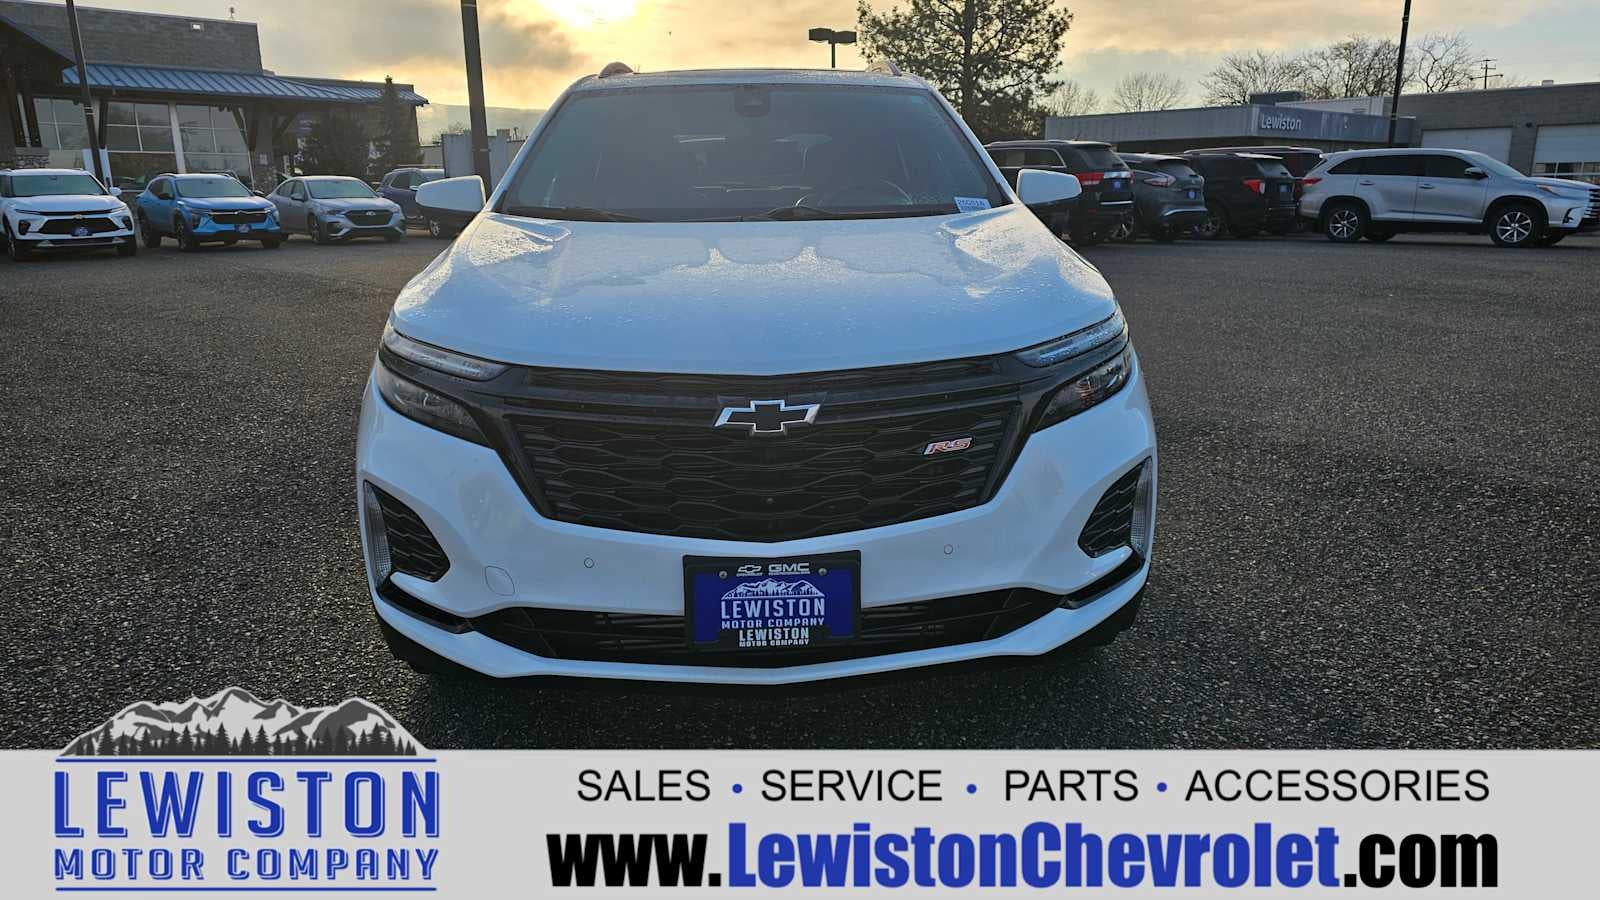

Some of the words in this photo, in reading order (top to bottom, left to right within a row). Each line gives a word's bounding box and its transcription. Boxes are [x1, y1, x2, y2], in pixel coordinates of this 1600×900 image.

[1261, 113, 1302, 130] Lewiston
[923, 437, 973, 455] RS
[768, 562, 810, 573] GMC
[720, 598, 826, 619] LEWISTON
[721, 619, 763, 630] MOTOR
[767, 617, 825, 628] COMPANY
[739, 628, 810, 641] LEWISTON
[739, 640, 767, 648] MOTOR
[770, 638, 810, 647] COMPANY
